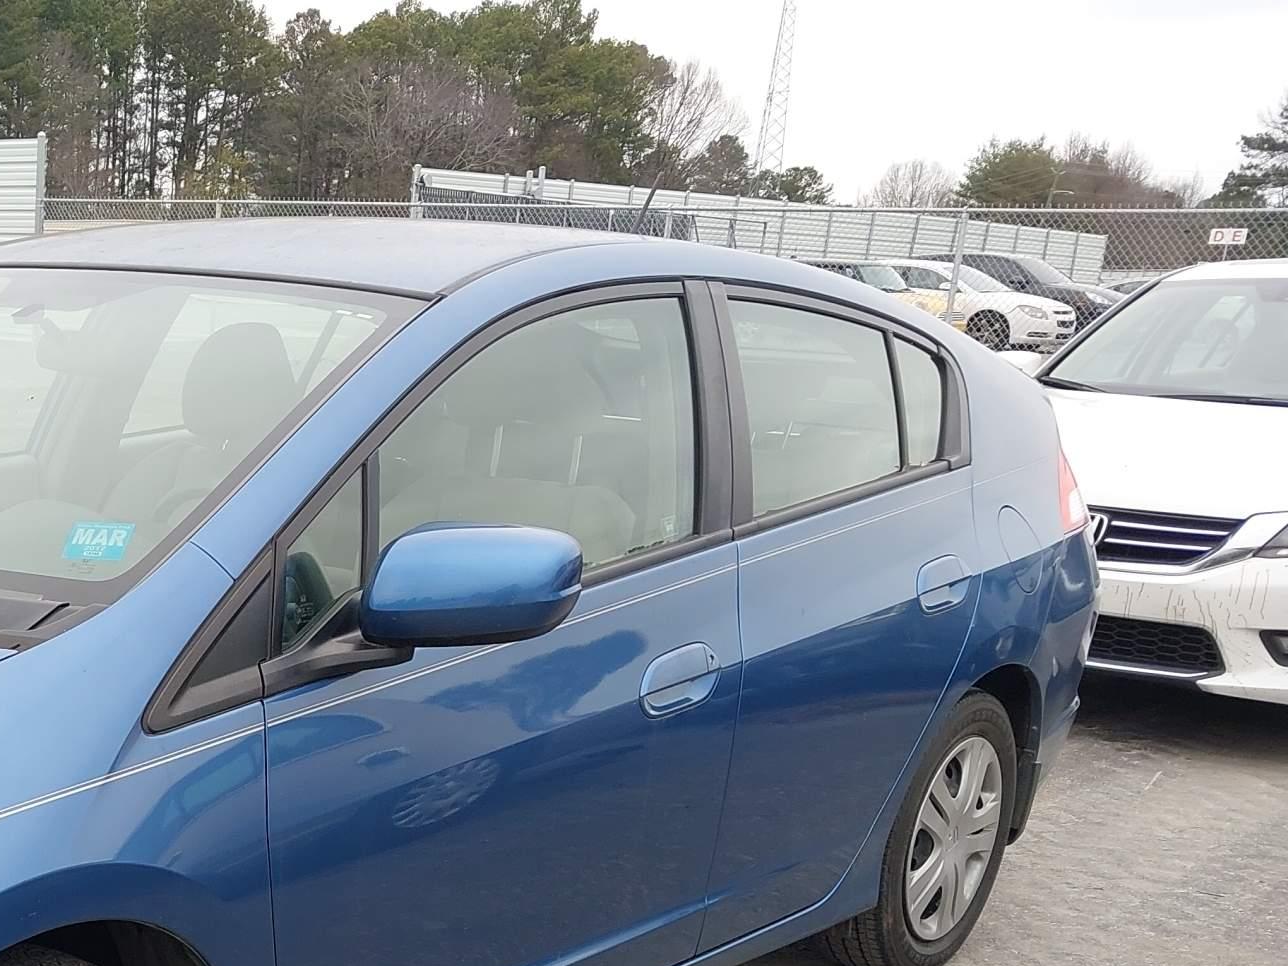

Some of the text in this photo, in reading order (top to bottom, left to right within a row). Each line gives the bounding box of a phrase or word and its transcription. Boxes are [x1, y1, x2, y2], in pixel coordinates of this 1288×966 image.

[1213, 230, 1244, 243] D E
[71, 527, 129, 547] MAR
